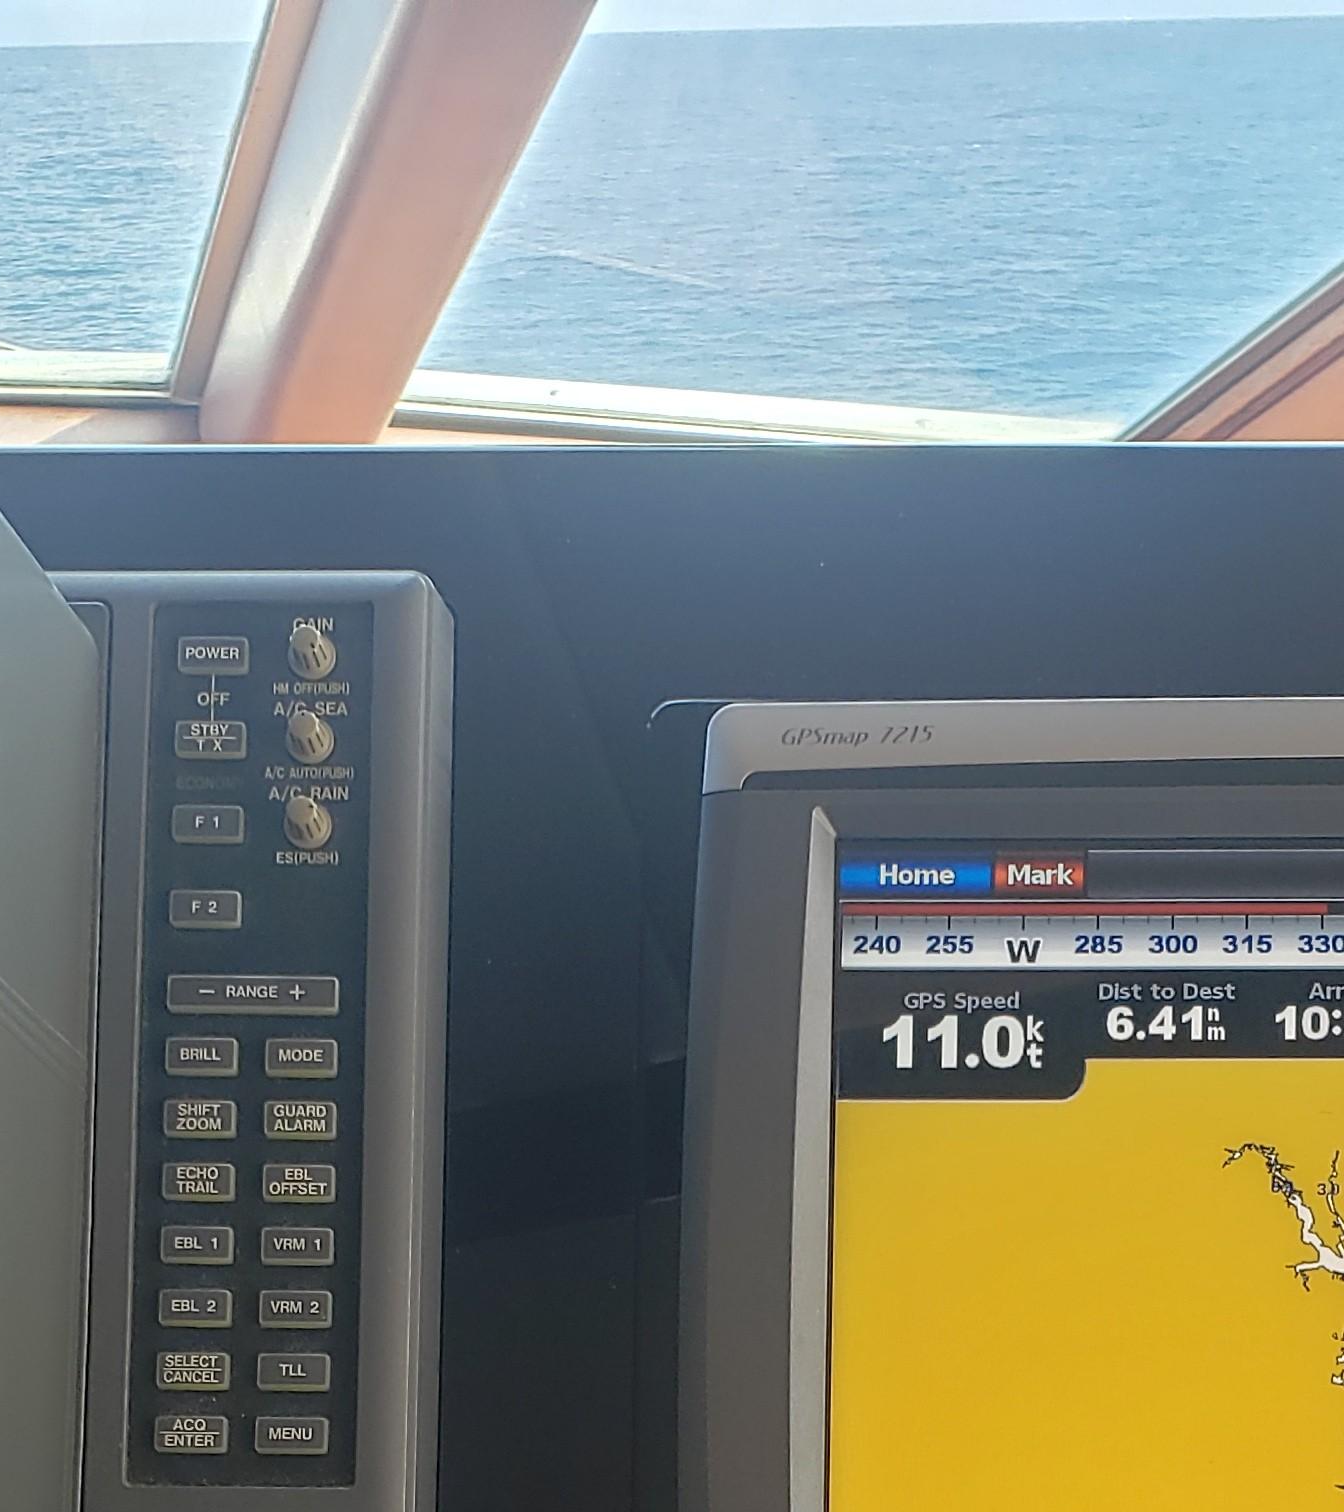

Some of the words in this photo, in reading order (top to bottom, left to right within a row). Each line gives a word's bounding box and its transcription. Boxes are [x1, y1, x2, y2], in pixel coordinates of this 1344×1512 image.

[185, 647, 239, 660] POWER
[273, 682, 289, 695] HM
[293, 681, 350, 696] OFF(PUSH)
[197, 693, 230, 706] OFF
[315, 701, 348, 716] SEA
[190, 724, 229, 737] STBY
[781, 727, 869, 747] GPSmap
[880, 725, 935, 744] 7215
[311, 787, 348, 801] RAIN
[276, 852, 339, 866] ES(PUSH)
[879, 863, 956, 886] Home
[1007, 863, 1074, 885] Mark
[853, 935, 902, 955] 240
[926, 935, 975, 955] 255
[1007, 938, 1042, 964] W
[1074, 935, 1123, 954] 285
[1148, 935, 1198, 955] 300
[1222, 934, 1273, 954] 315
[226, 985, 279, 999] RANGE
[1099, 983, 1142, 1001] Dist
[1150, 984, 1175, 1000] to
[1183, 983, 1236, 1001] Dest
[903, 993, 946, 1010] GPS
[955, 991, 1021, 1013] Speed
[1106, 1005, 1205, 1041] 6.41
[882, 1014, 1025, 1069] 11.0
[180, 1048, 221, 1061] BRILL
[278, 1049, 324, 1062] MODE
[177, 1104, 221, 1117] SHIFT
[274, 1105, 327, 1118] GUARD
[176, 1117, 222, 1130] ZOOM
[274, 1119, 326, 1132] ALARM
[176, 1167, 219, 1180] ECHO
[284, 1168, 312, 1181] EBL
[176, 1181, 219, 1194] TRAIL
[269, 1182, 327, 1195] OFFSET
[174, 1237, 203, 1249] EBL
[273, 1238, 306, 1250] VRM
[171, 1300, 200, 1312] EBL
[207, 1300, 217, 1312] 2
[271, 1301, 303, 1313] VRM
[310, 1301, 320, 1314] 2
[165, 1355, 218, 1368] SELECT
[163, 1371, 219, 1383] CANCEL
[279, 1364, 307, 1377] TLL
[172, 1418, 207, 1432] ACQ
[269, 1427, 313, 1440] MENU
[164, 1435, 215, 1447] ENTER
